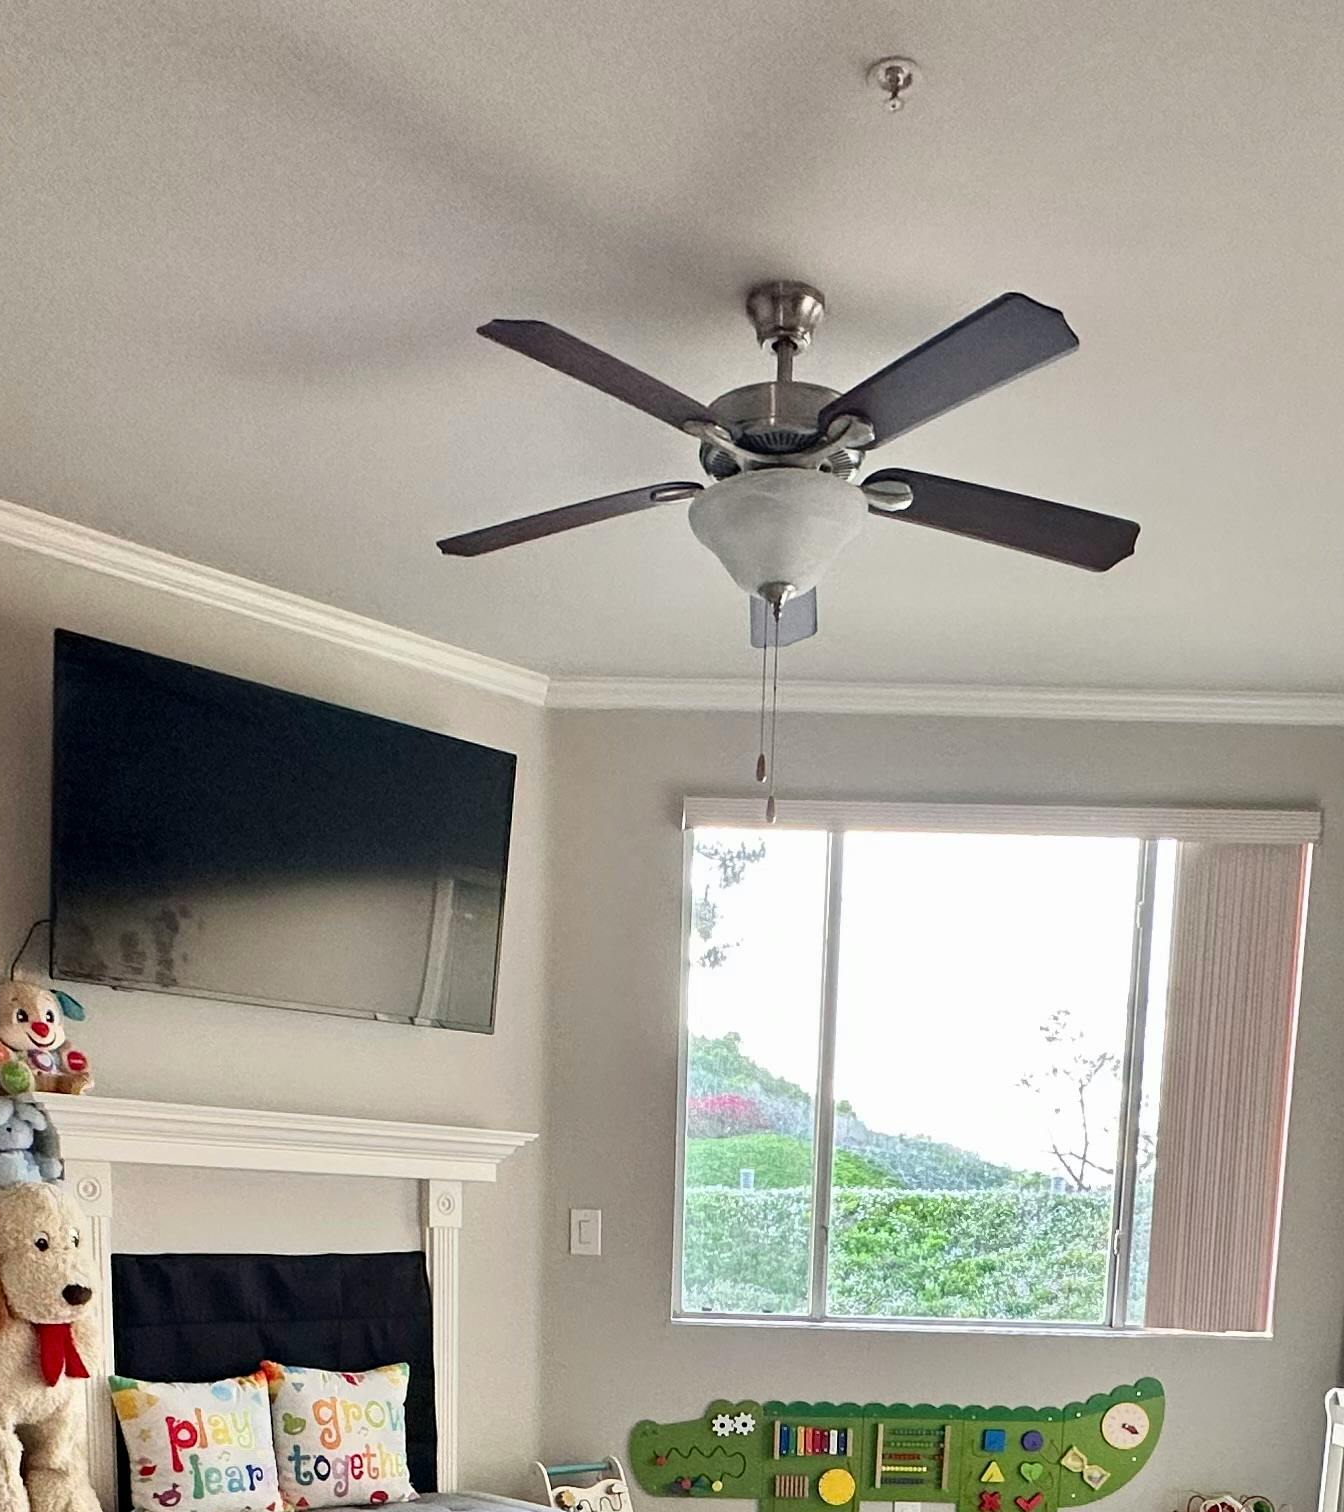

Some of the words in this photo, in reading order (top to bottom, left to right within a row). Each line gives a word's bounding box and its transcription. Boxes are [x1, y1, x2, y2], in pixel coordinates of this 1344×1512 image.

[164, 1406, 253, 1473] play
[189, 1453, 268, 1499] lear
[287, 1443, 407, 1498] togethe
